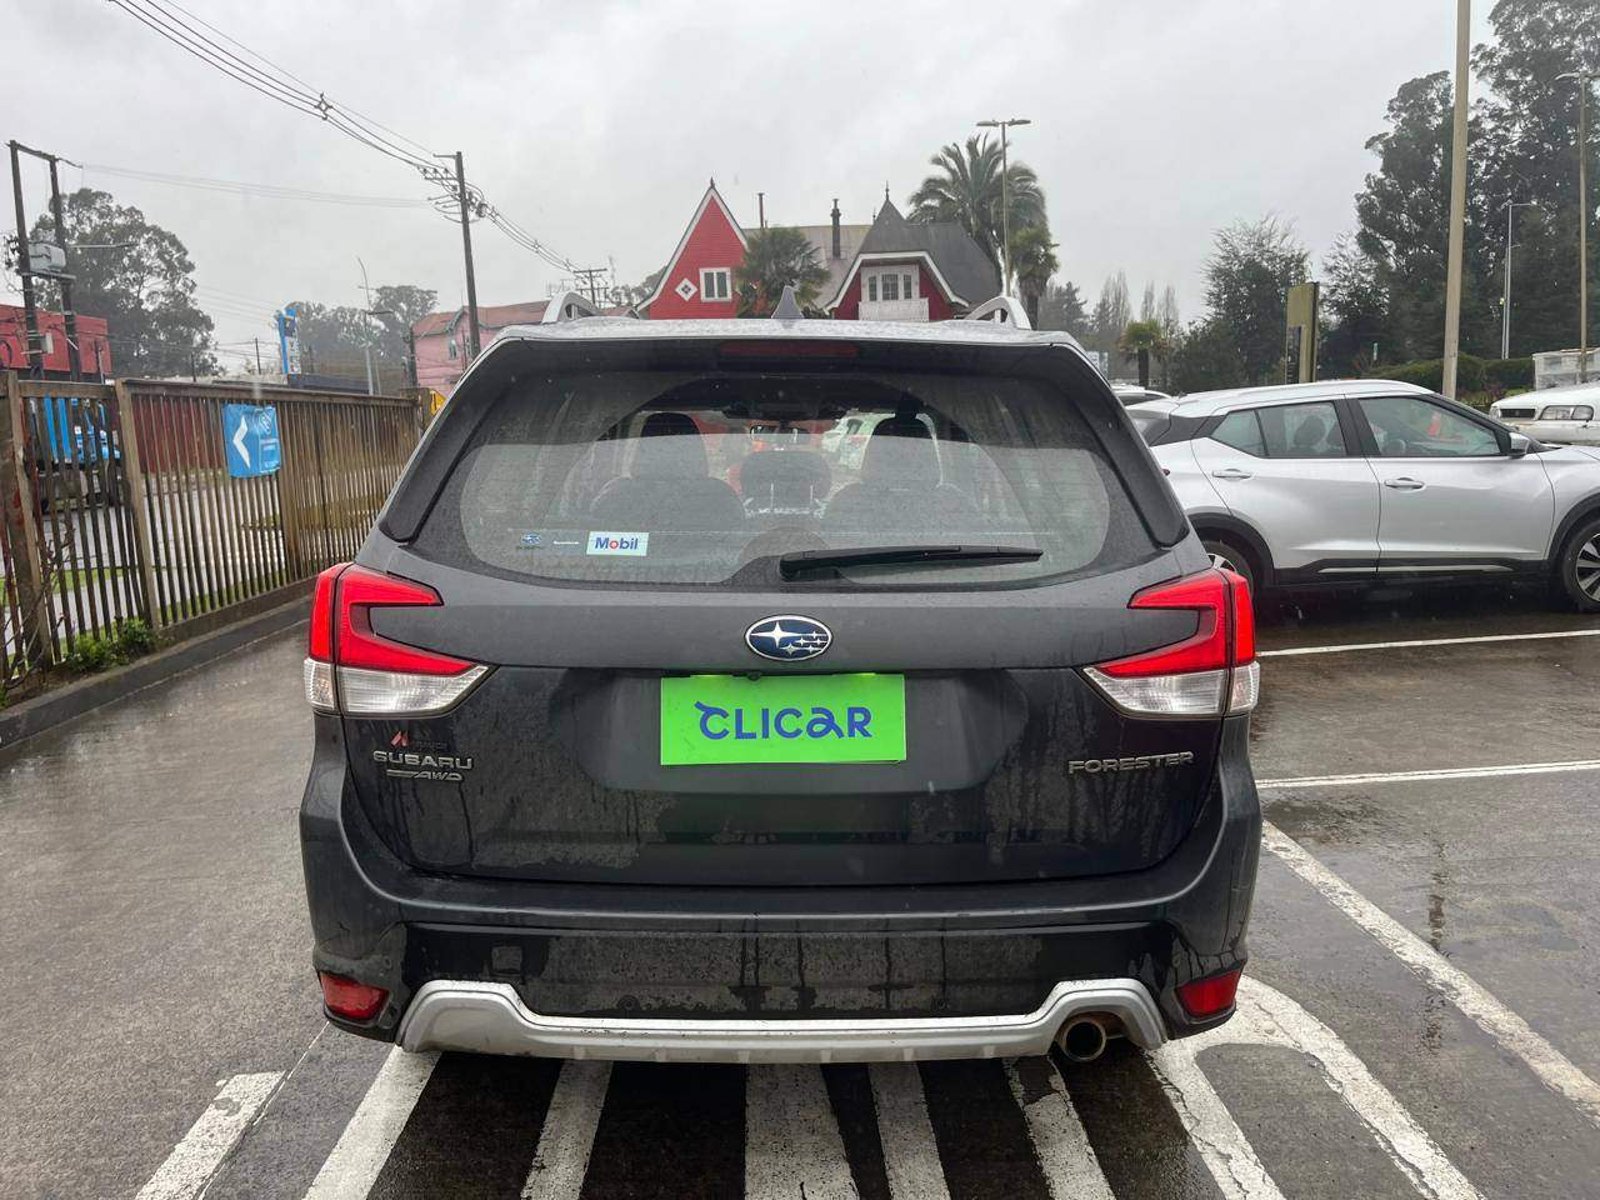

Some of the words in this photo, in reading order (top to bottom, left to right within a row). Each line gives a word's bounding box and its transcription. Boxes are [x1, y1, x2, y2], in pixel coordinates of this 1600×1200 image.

[594, 537, 639, 550] Mobil
[373, 750, 473, 770] SUBARU
[1068, 751, 1194, 774] FORESTER
[414, 770, 463, 781] AWD
